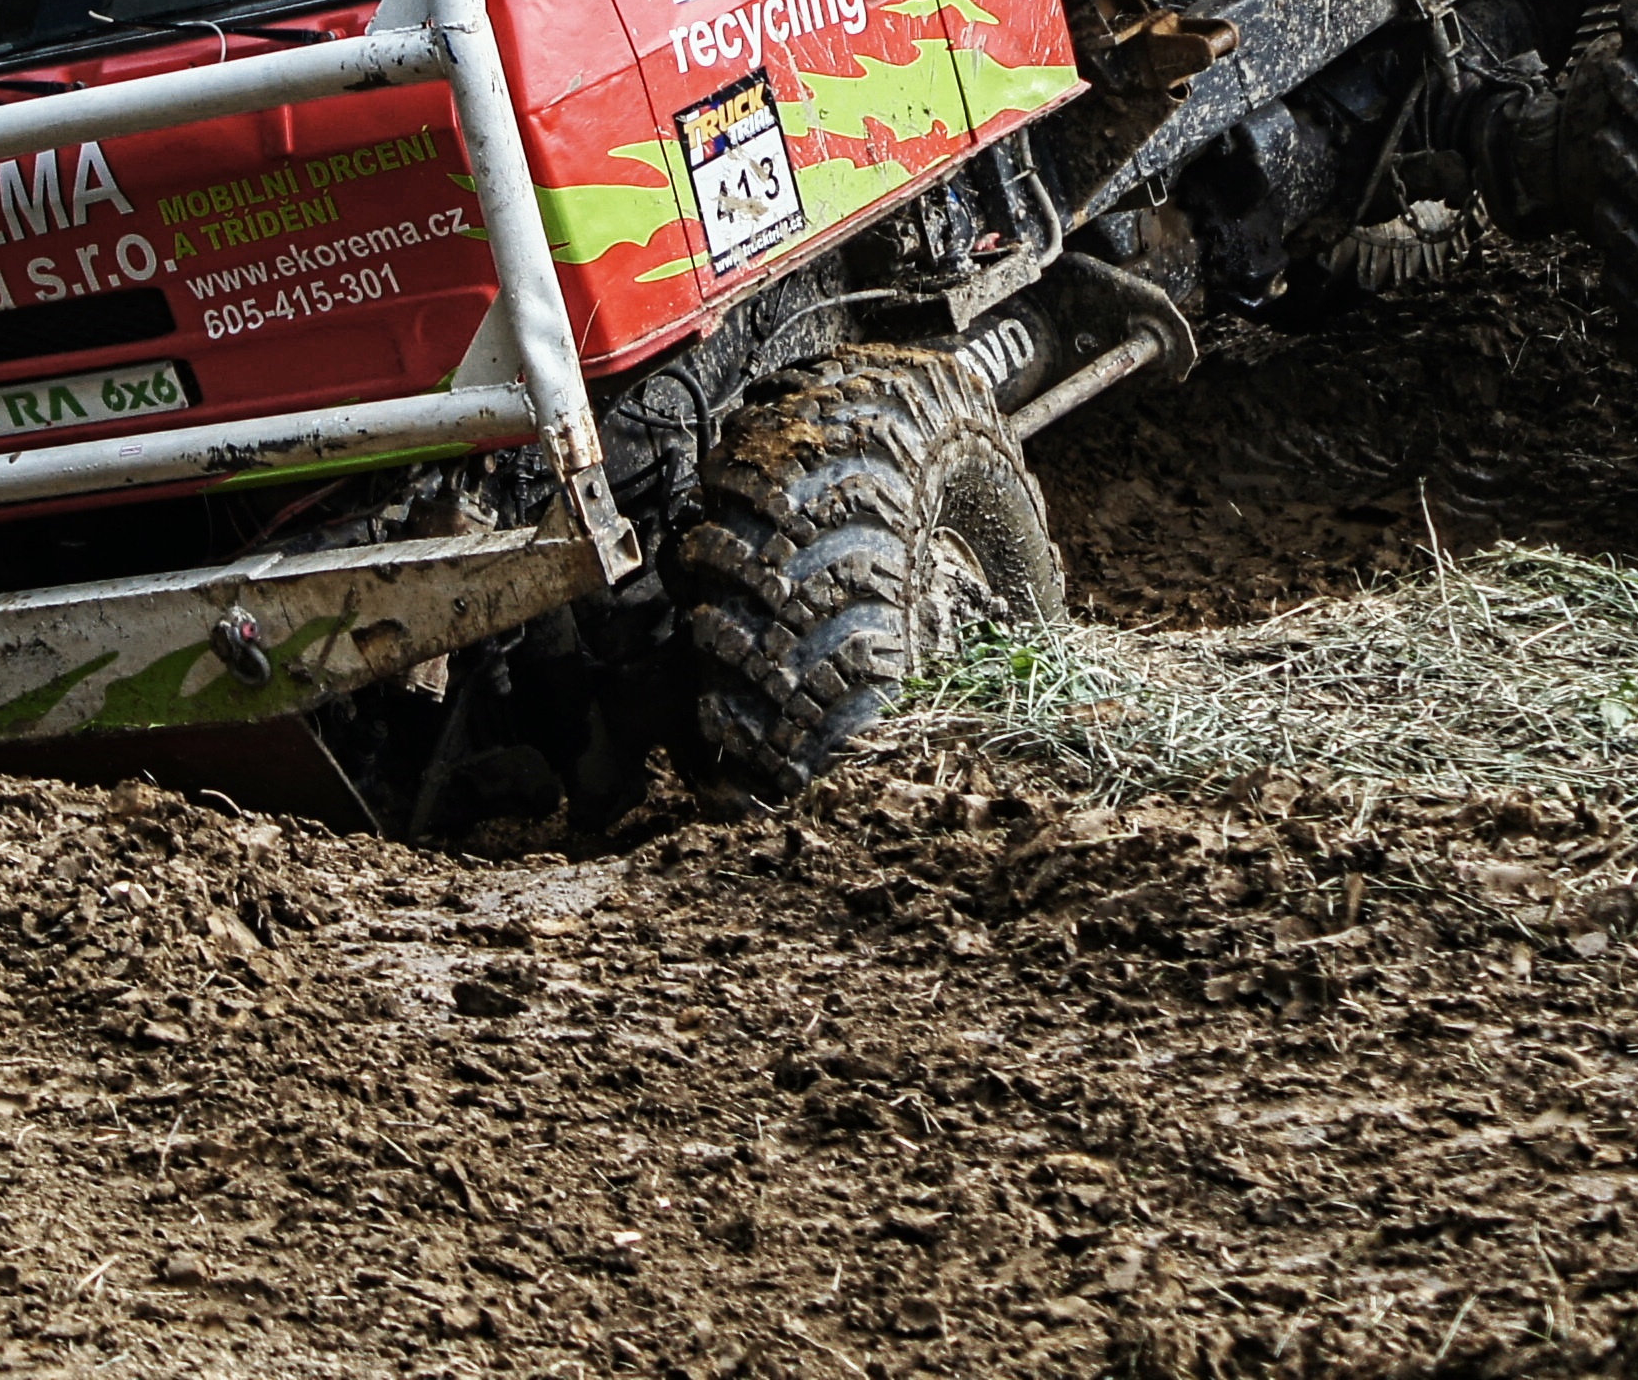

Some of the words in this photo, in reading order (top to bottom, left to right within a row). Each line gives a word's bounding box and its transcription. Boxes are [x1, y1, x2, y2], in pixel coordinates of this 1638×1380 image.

[684, 82, 765, 149] TRUCK
[727, 104, 776, 146] TRIAL
[157, 160, 300, 226] MOBILNÍ
[305, 123, 439, 189] DRCENÍ
[716, 156, 780, 225] 413
[174, 232, 198, 260] A
[199, 188, 340, 251] TŘÍDĚNÍ
[185, 207, 471, 301] www.ekorema.cz
[26, 233, 178, 302] s.r.o.
[203, 262, 402, 340] 605-415-301
[100, 370, 179, 413] 6x6
